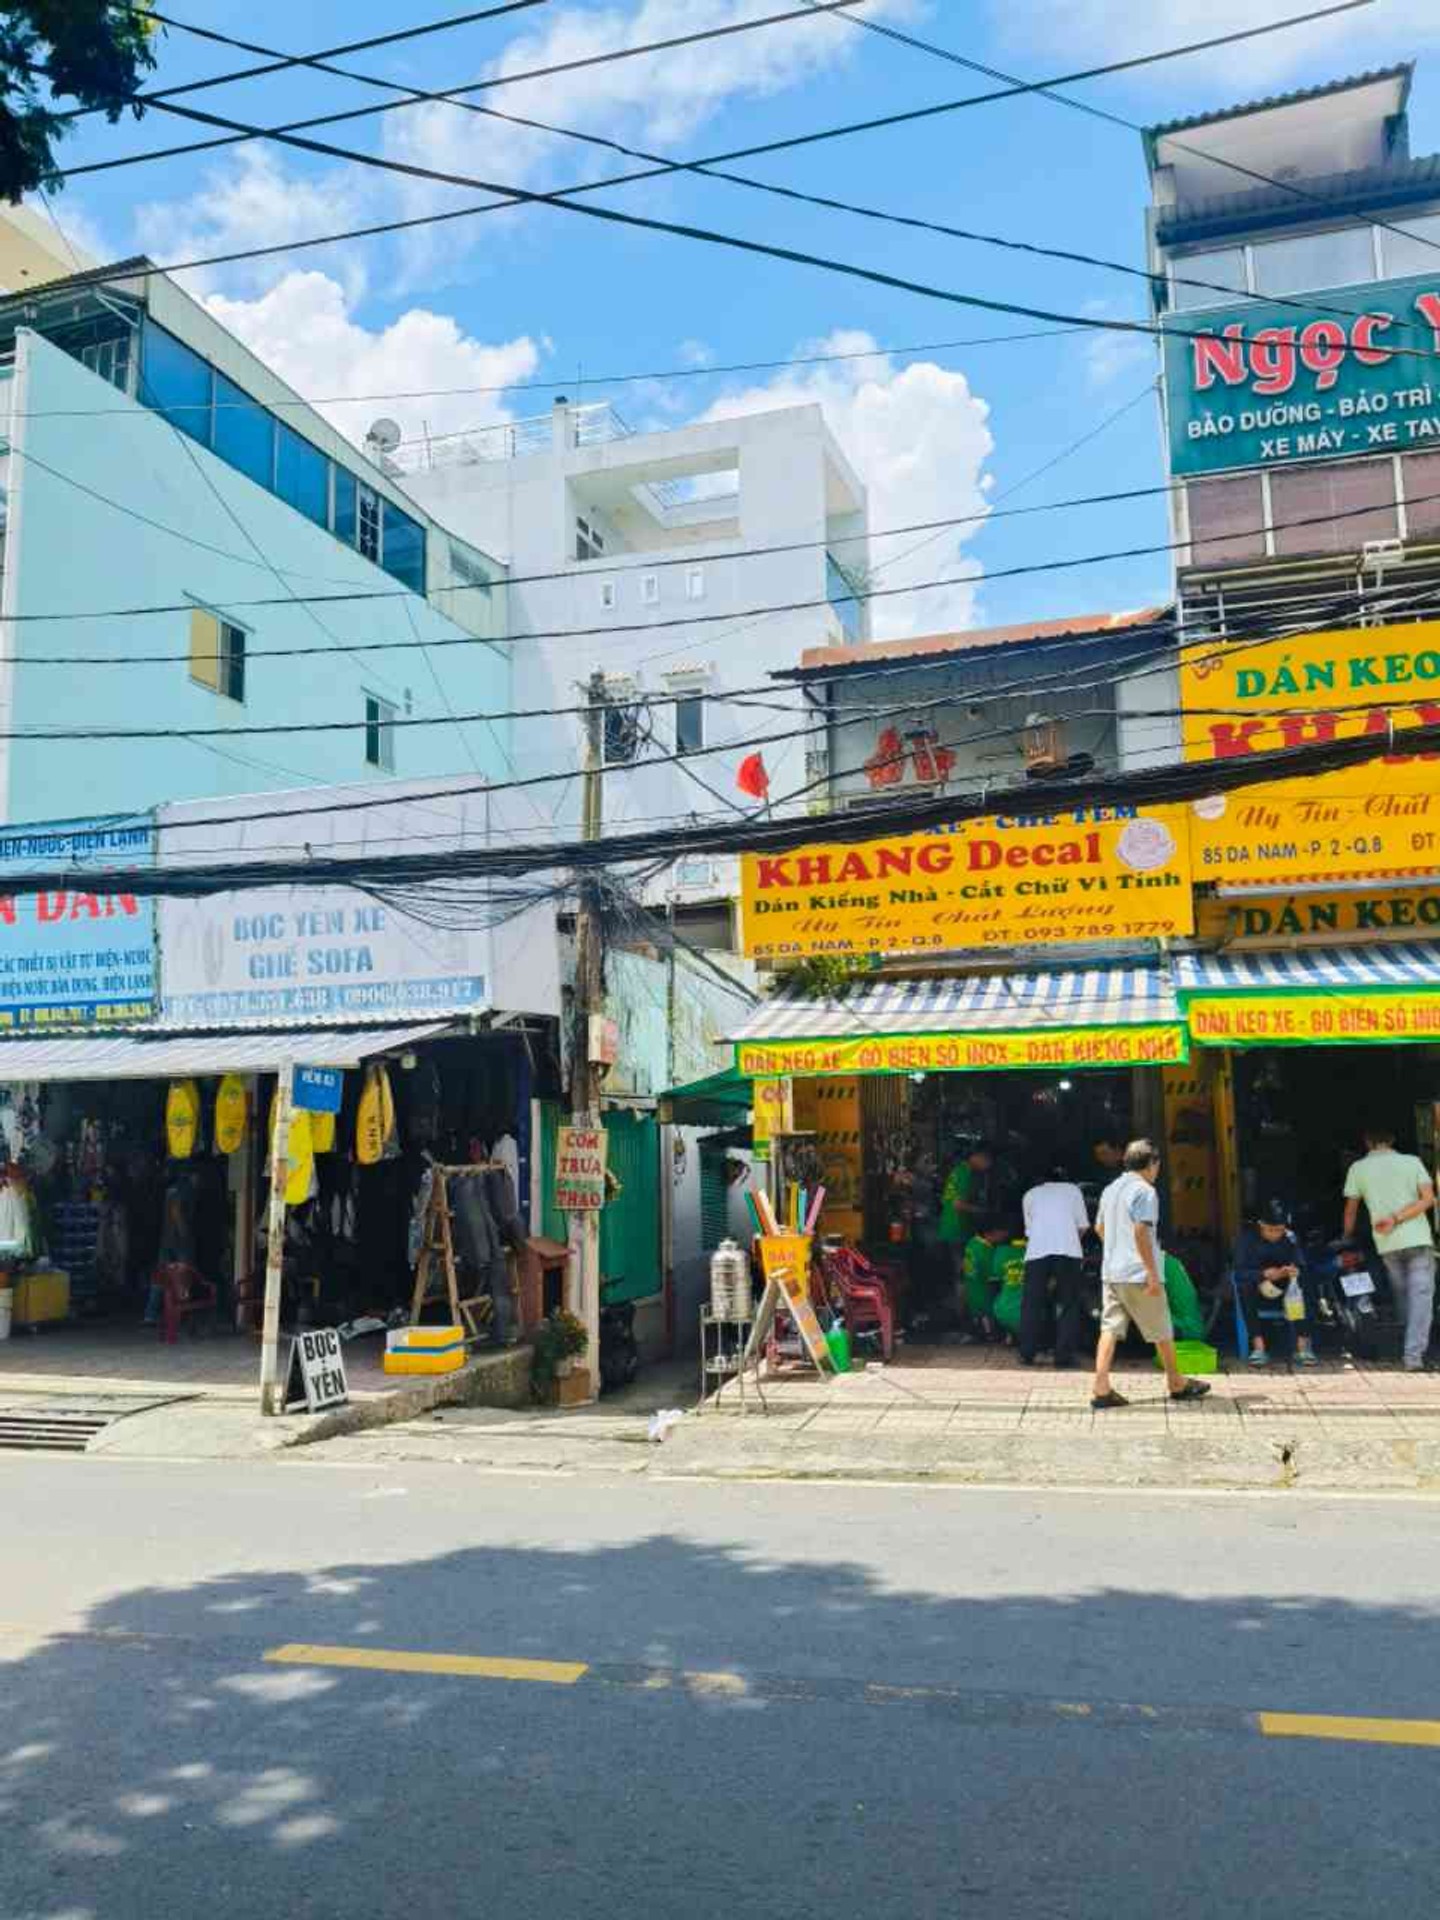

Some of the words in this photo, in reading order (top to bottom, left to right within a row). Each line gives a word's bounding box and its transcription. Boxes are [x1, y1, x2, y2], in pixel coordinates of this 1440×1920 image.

[1193, 312, 1394, 395] Ngọc
[1260, 437, 1290, 457] XE
[1297, 427, 1345, 453] MÁY
[1367, 422, 1398, 442] XE
[1236, 655, 1335, 697] DÁN
[1350, 651, 1440, 687] KEO
[757, 842, 954, 888] KHANG
[967, 833, 1102, 871] Decal
[1257, 843, 1297, 860] NAM
[307, 946, 373, 975] SOFA
